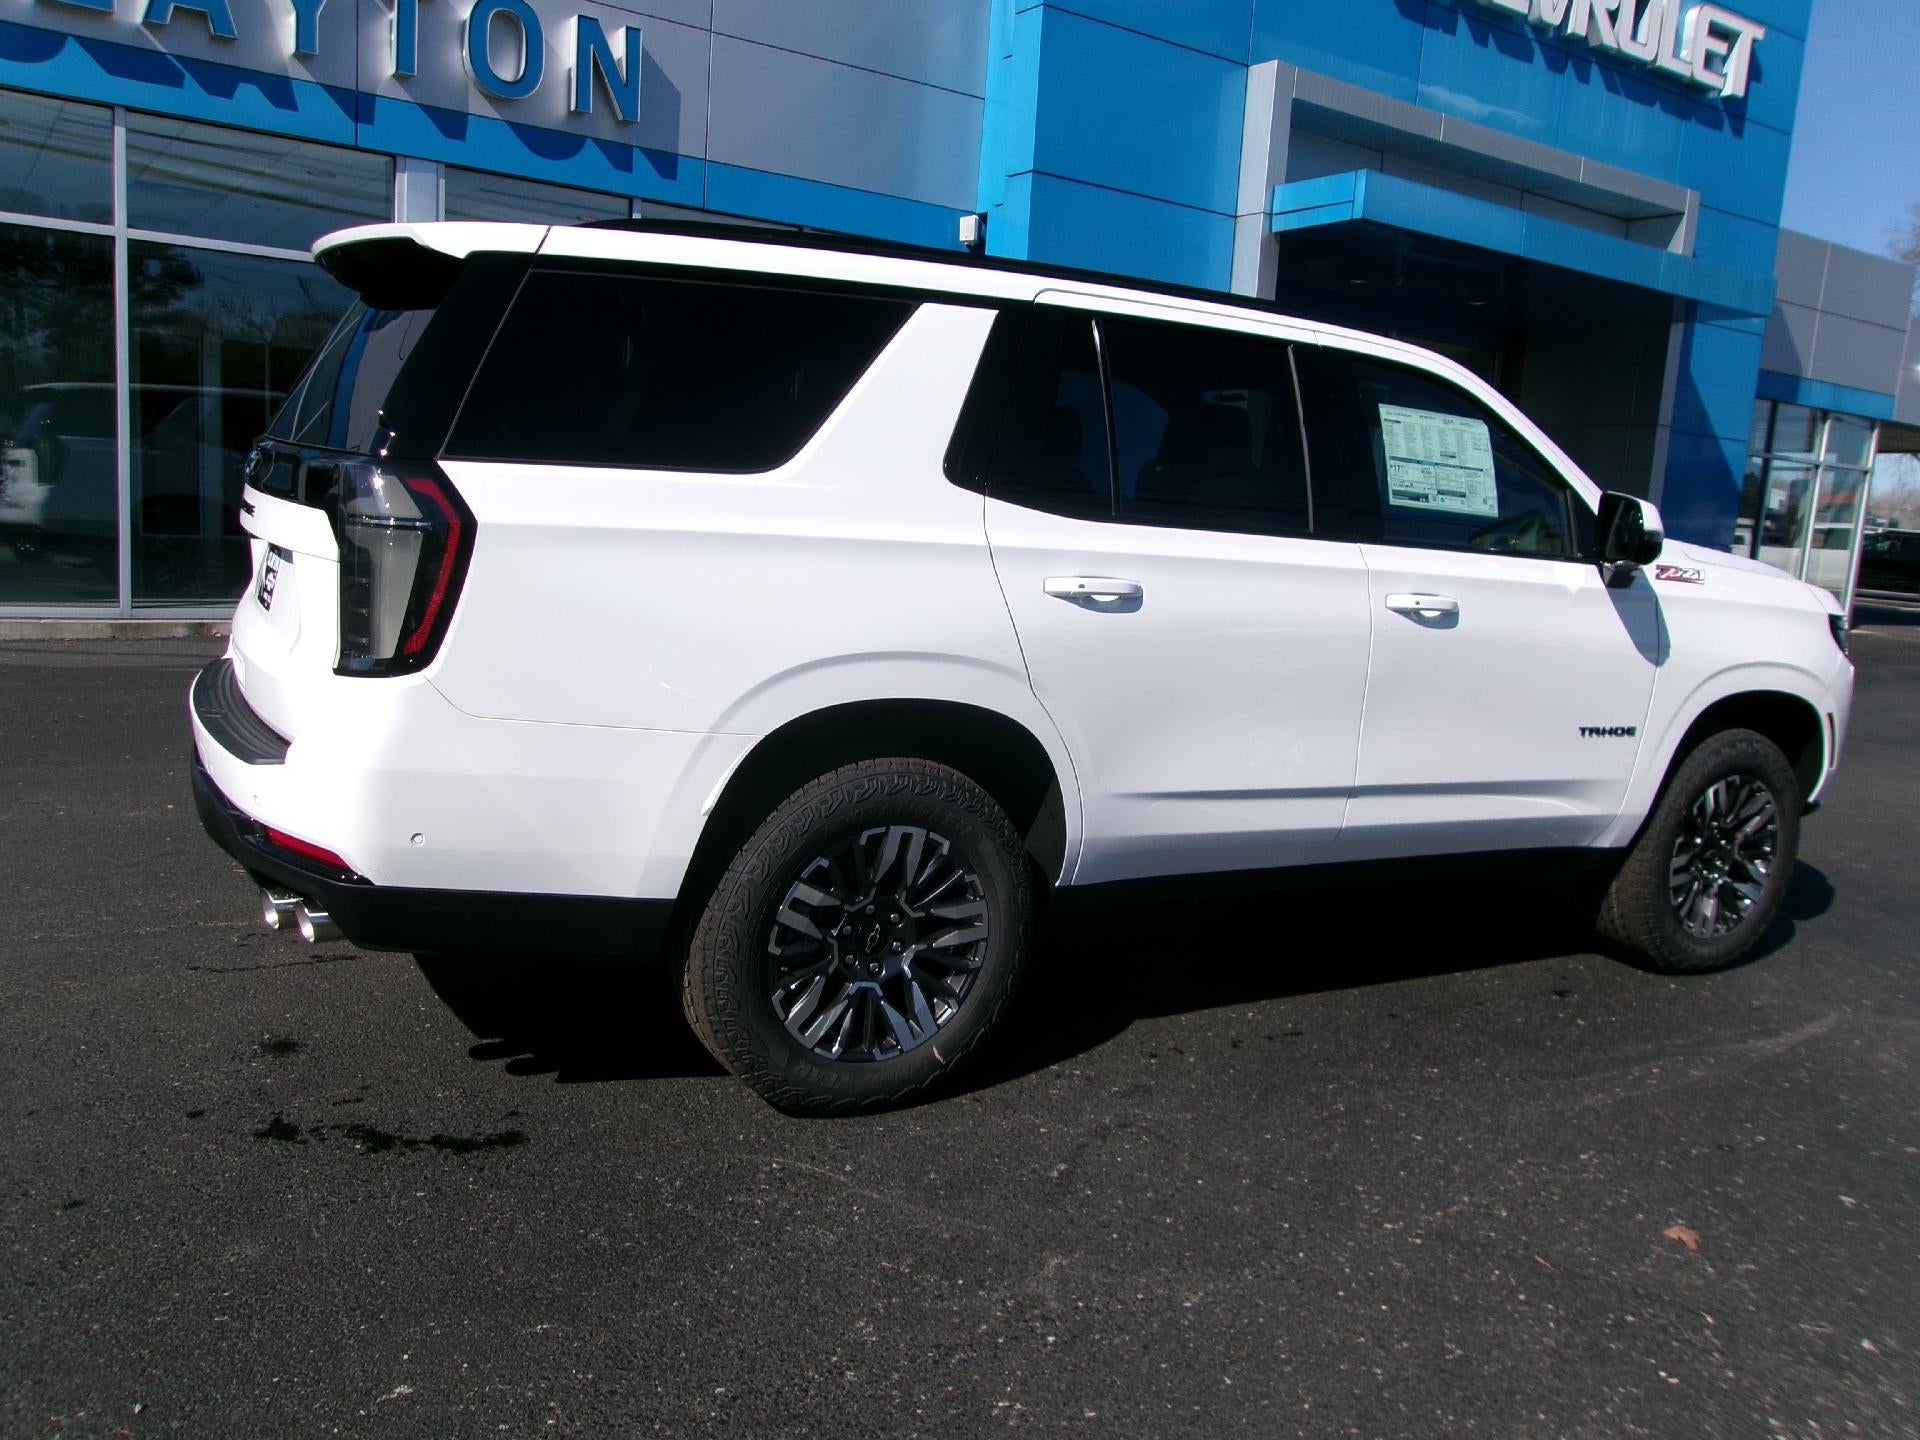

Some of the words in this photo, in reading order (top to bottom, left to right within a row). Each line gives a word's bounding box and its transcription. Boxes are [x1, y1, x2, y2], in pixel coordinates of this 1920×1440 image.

[36, 0, 643, 122] YTON
[1482, 0, 1765, 99] ROLET
[1578, 726, 1637, 738] TAHOE
